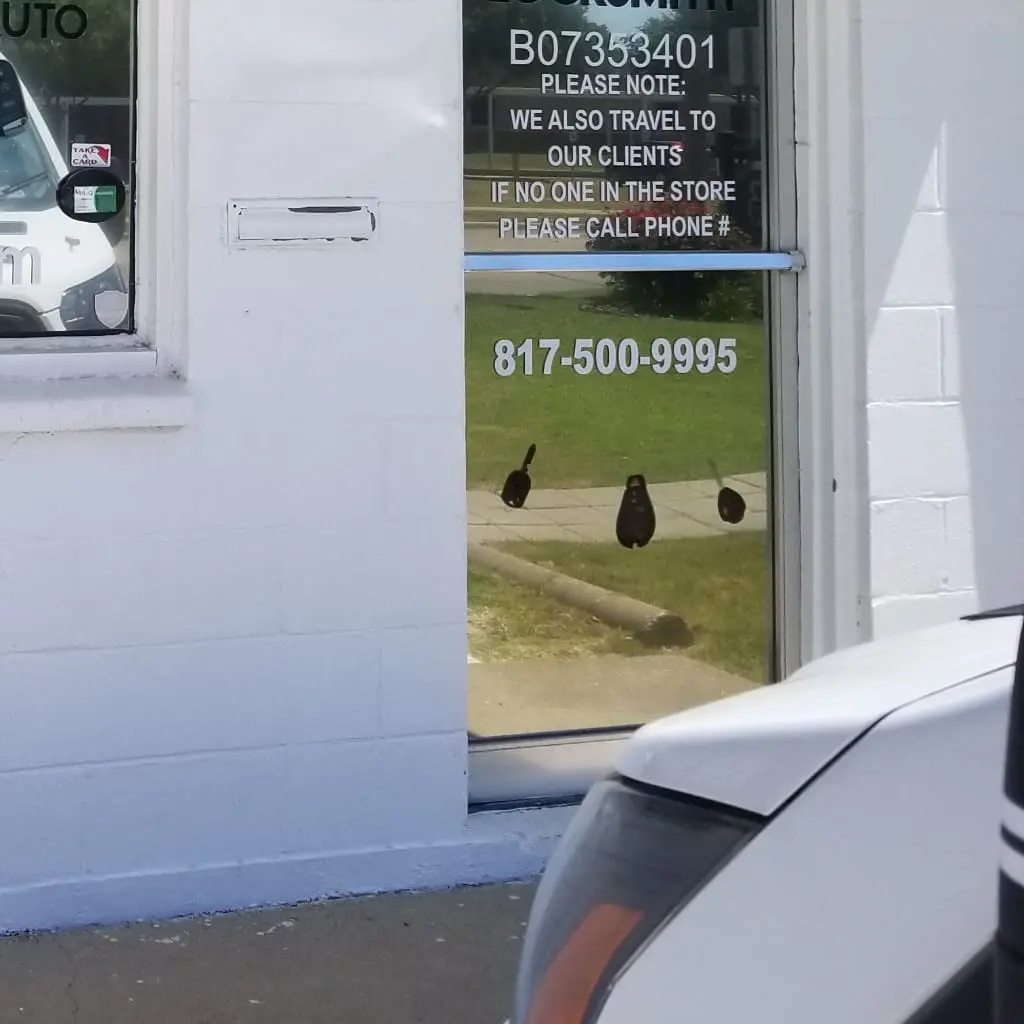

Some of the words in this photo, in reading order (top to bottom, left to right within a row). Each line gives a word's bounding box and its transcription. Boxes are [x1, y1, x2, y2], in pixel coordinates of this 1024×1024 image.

[510, 29, 714, 69] B07353401
[541, 73, 621, 95] PLEASE
[626, 75, 686, 96] NOTE:
[510, 109, 543, 130] WE
[547, 109, 604, 131] ALSO
[608, 109, 686, 131] TRAVEL
[689, 109, 716, 131] TO
[73, 146, 97, 154] TAKE
[547, 145, 593, 166] OUR
[598, 145, 682, 167] CLIENTS
[72, 158, 98, 166] CARD
[491, 181, 509, 203] IF
[515, 181, 546, 203] NO
[551, 181, 595, 203] ONE
[600, 180, 619, 202] IN
[625, 180, 665, 203] THE
[670, 180, 736, 202] STORE
[499, 217, 580, 239] PLEASE
[586, 217, 640, 238] CALL
[645, 216, 713, 238] PHONE
[718, 215, 731, 237] #
[493, 337, 737, 377] 817-500-9995
